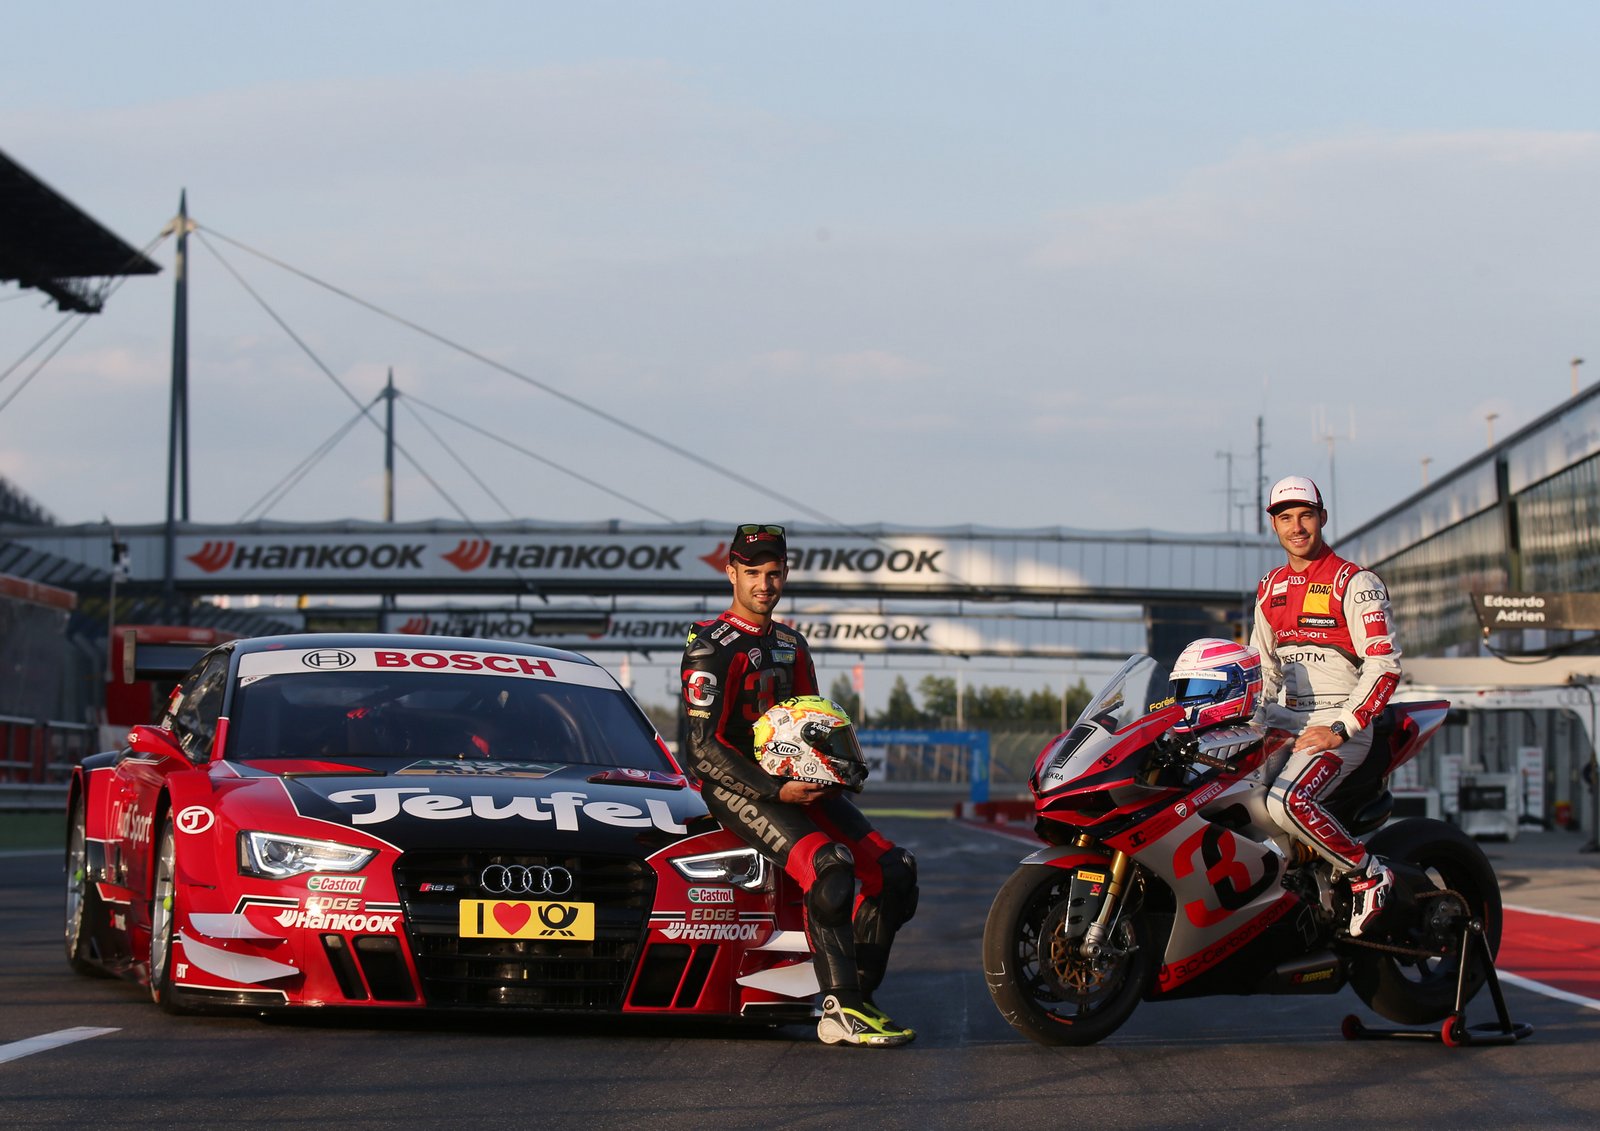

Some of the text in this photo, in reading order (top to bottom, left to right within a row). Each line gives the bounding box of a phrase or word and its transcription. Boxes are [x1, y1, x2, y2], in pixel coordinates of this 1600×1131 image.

[1309, 584, 1332, 595] ADAC
[1484, 594, 1546, 608] Edoardo
[1363, 612, 1385, 625] RACC
[1495, 609, 1546, 622] Adrien
[374, 651, 557, 678] BOSCH
[1295, 652, 1326, 663] DTM
[1149, 696, 1176, 713] Forés
[696, 760, 761, 800] DUCATI
[1295, 765, 1330, 801] Sport
[1192, 781, 1224, 806] PIRELLI
[327, 787, 688, 835] Teufel
[132, 804, 153, 849] Sport
[712, 786, 788, 853] DUCATI
[320, 877, 362, 893] Castrol
[699, 889, 732, 902] Castrol
[304, 897, 363, 912] EDGE
[690, 908, 737, 922] EDGE
